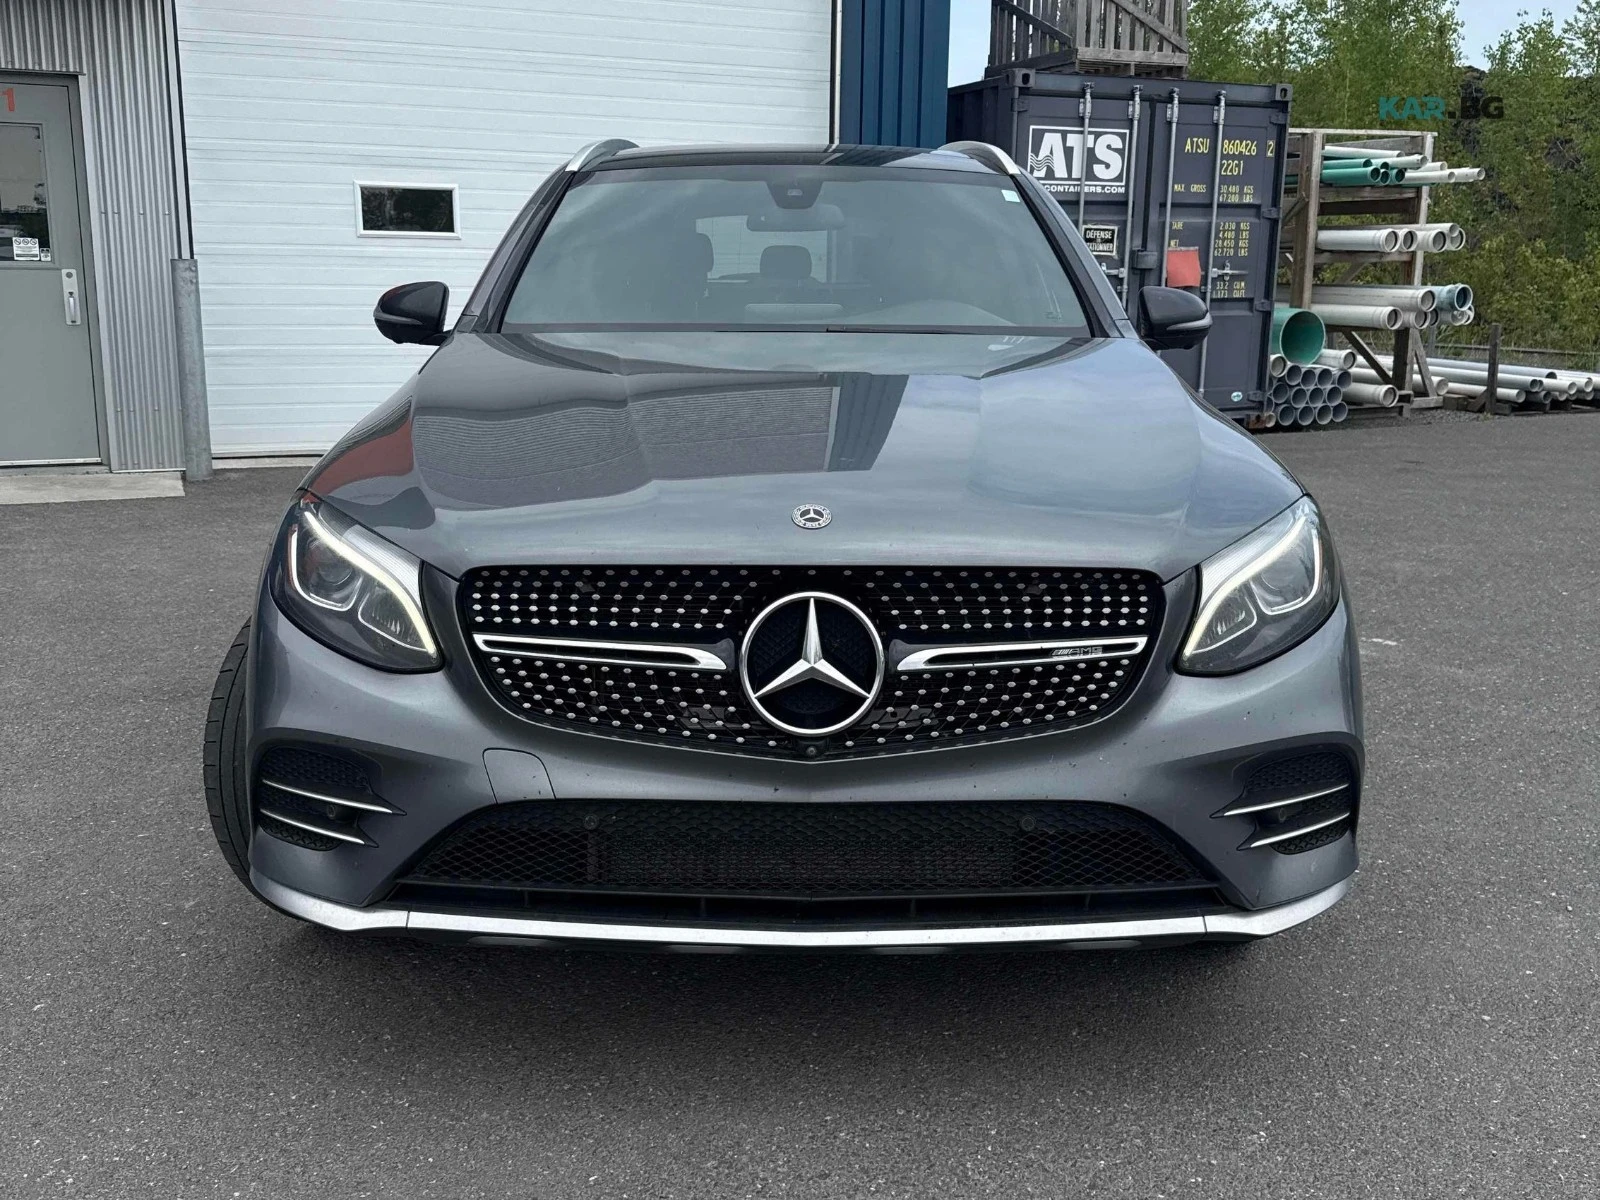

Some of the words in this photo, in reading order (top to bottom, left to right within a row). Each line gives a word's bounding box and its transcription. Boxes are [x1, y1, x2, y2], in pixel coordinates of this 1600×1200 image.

[0, 88, 15, 112] 1
[1032, 132, 1123, 180] ATS
[1185, 138, 1209, 153] ATSU
[1222, 139, 1257, 156] 860426
[1267, 141, 1274, 156] 2
[1221, 160, 1243, 175] 22G1
[1174, 184, 1185, 192] MAX
[1190, 184, 1207, 193] GROSS
